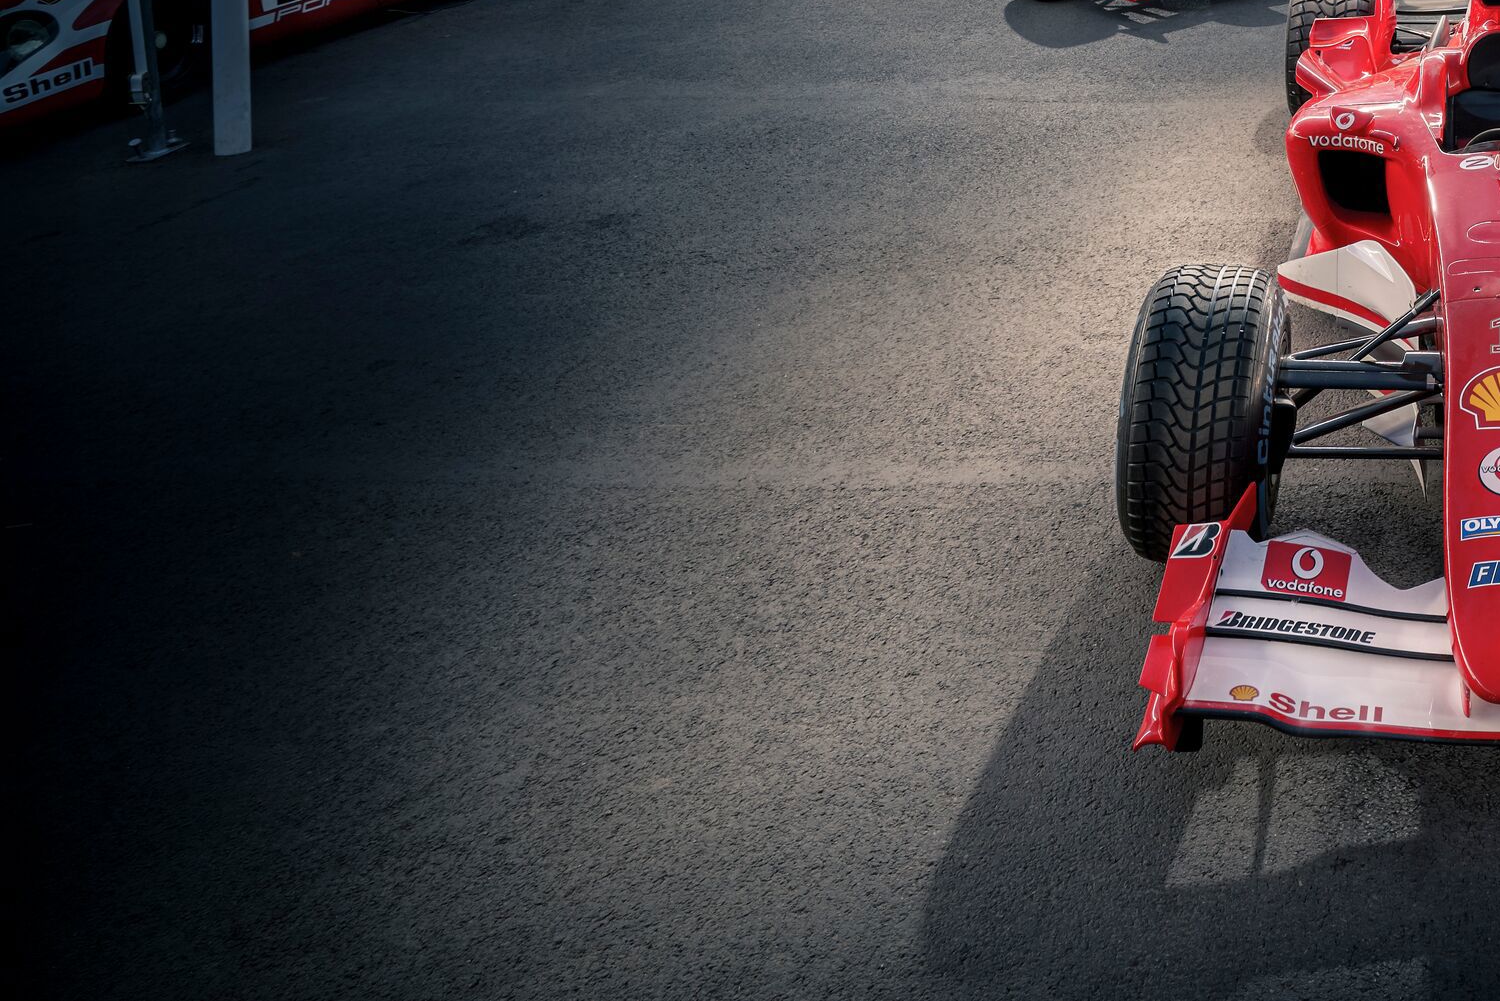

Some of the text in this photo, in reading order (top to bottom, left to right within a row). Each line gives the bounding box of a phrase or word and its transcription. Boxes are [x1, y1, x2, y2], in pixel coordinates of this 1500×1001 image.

[3, 60, 92, 103] Shell
[1308, 133, 1384, 154] vodafone
[1267, 578, 1344, 598] vodafone
[1215, 610, 1376, 644] BRIDGESTONE
[1268, 692, 1384, 722] Shell
